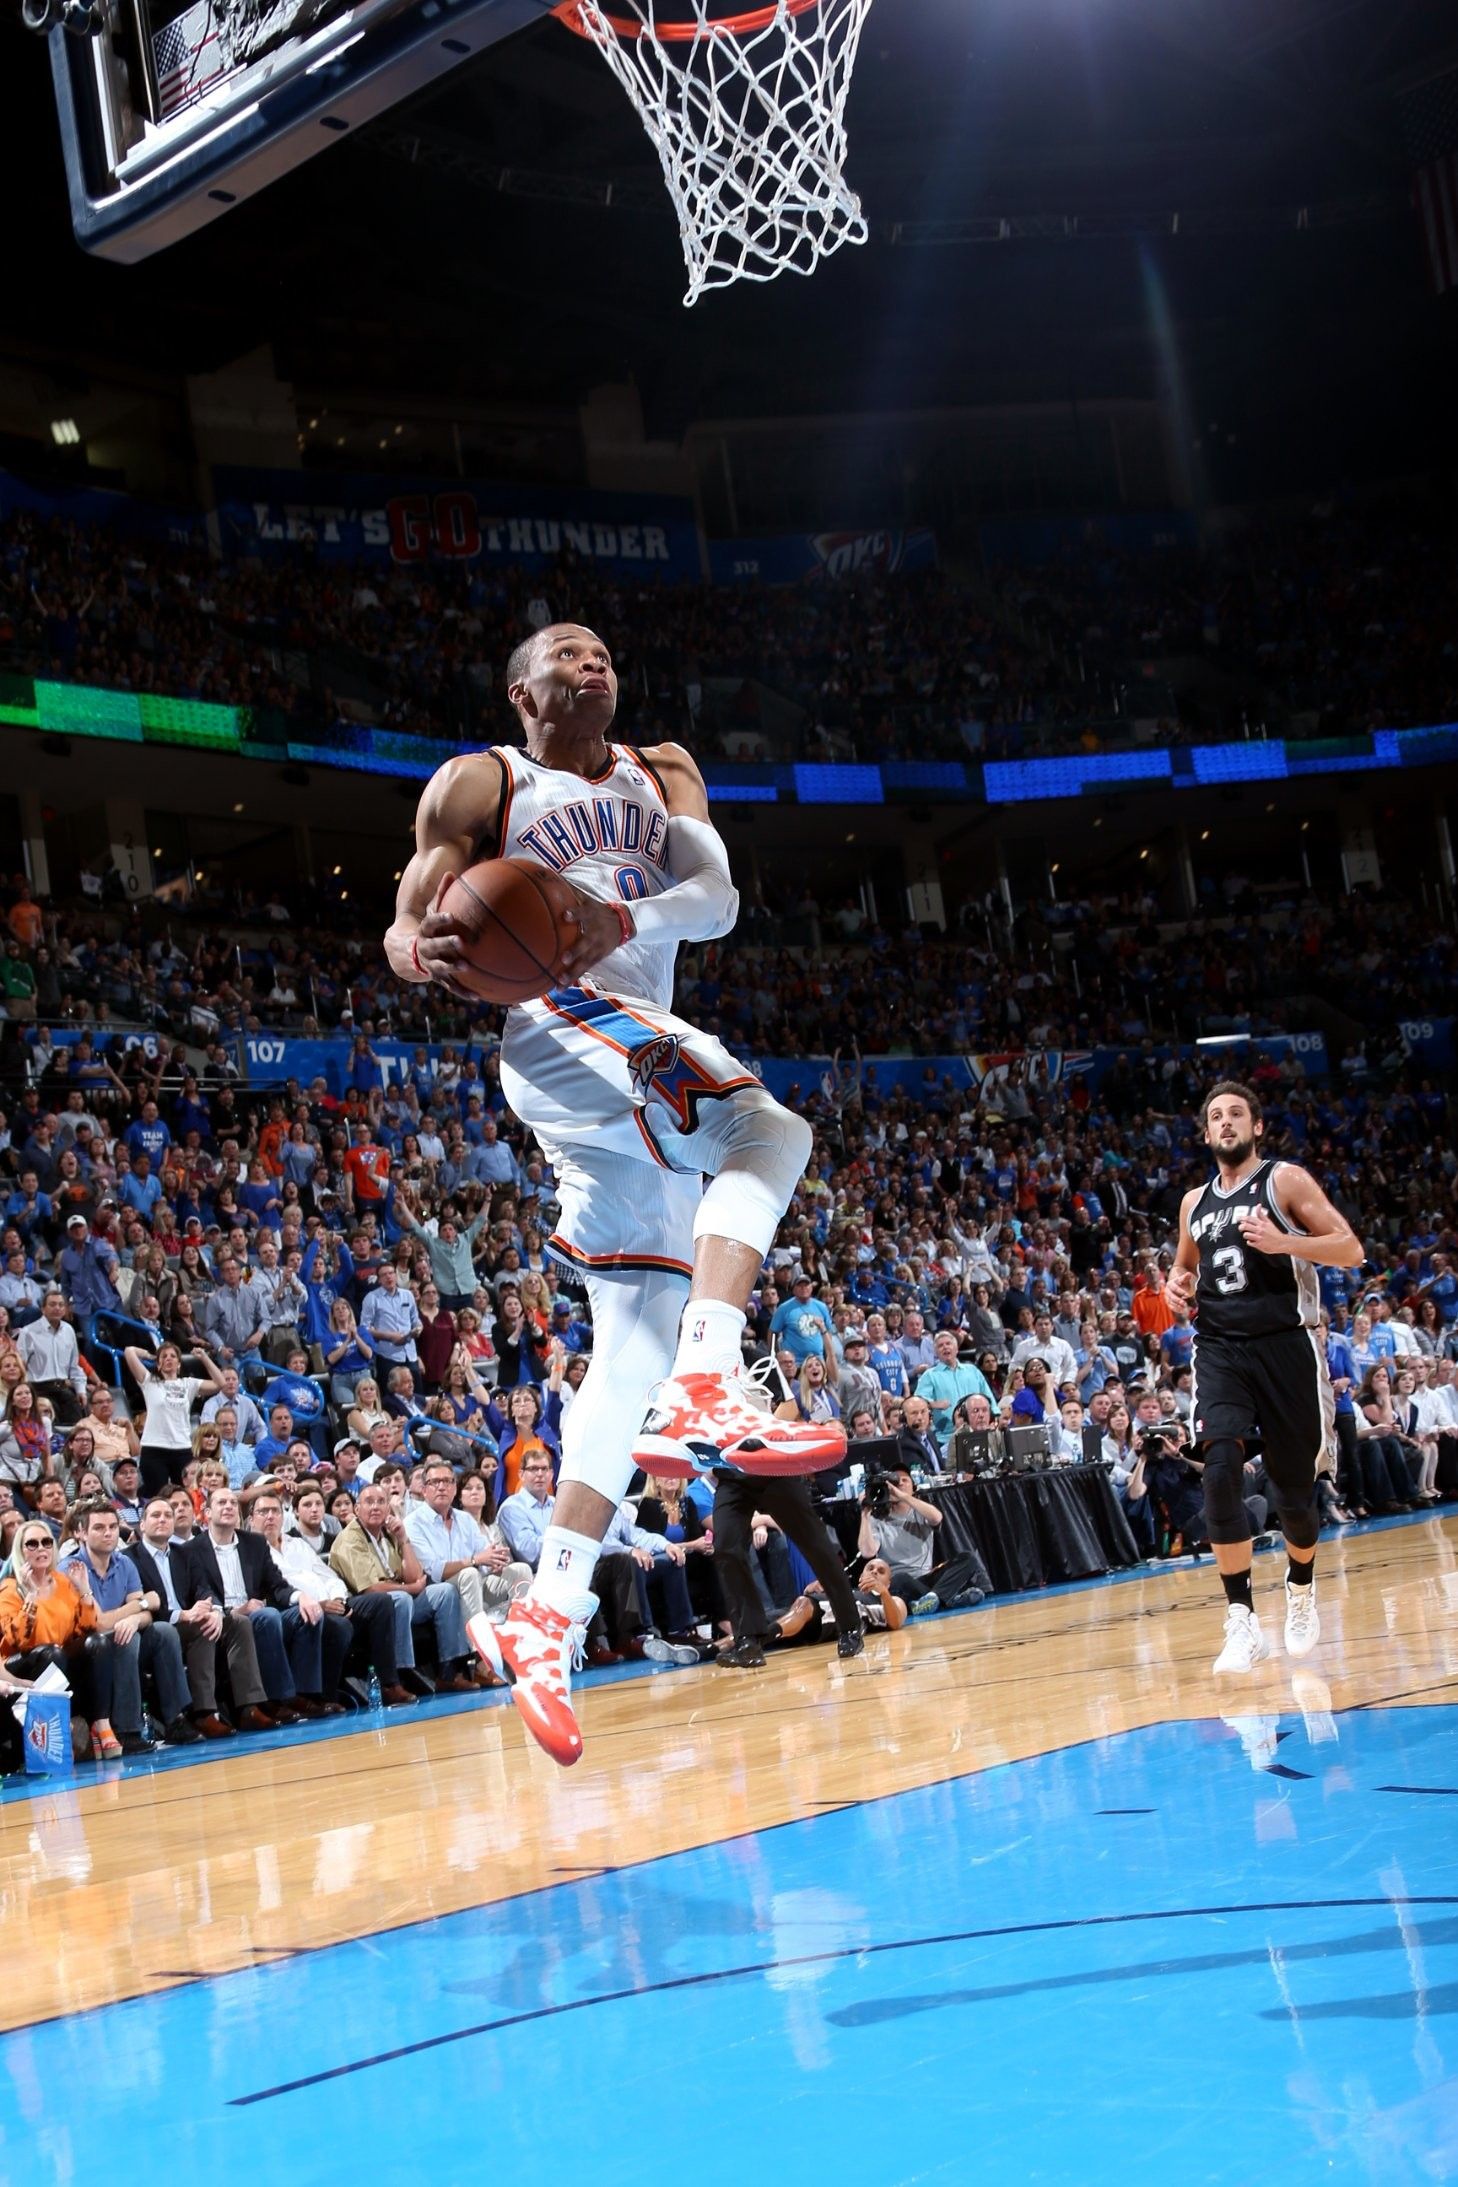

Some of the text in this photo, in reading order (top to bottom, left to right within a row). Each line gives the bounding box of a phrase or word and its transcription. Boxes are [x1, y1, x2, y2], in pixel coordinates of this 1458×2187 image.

[253, 492, 670, 563] LET'S GO THUNDER
[123, 831, 139, 892] 210
[614, 863, 650, 901] 0
[125, 1035, 158, 1059] 06
[247, 1040, 285, 1063] 107
[142, 1131, 163, 1140] TEAM
[1212, 1245, 1249, 1295] 3
[47, 1711, 65, 1765] THUNDER
